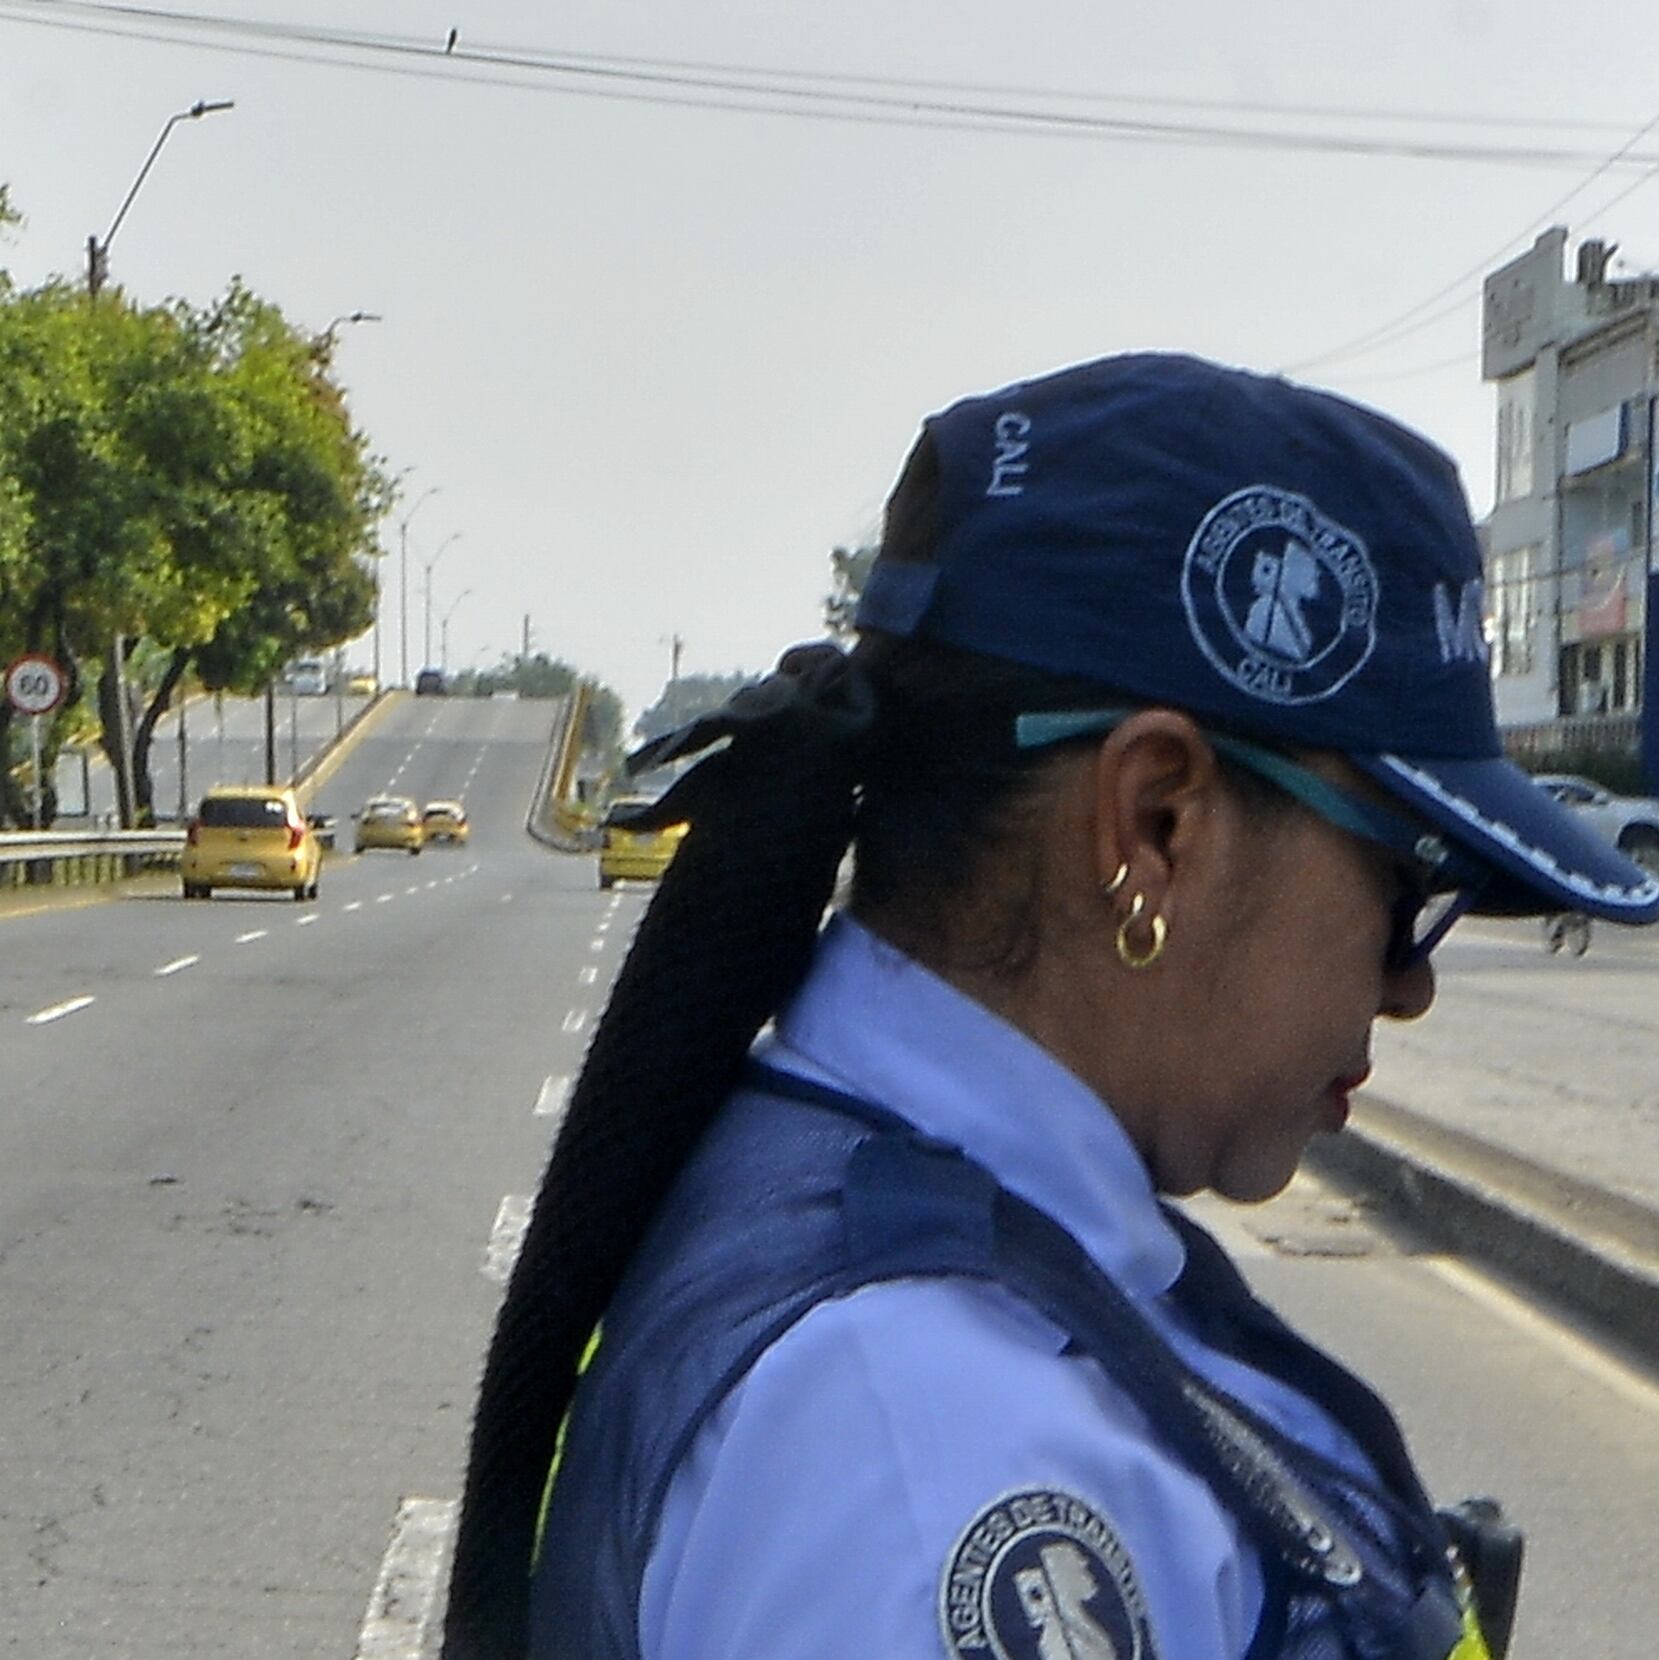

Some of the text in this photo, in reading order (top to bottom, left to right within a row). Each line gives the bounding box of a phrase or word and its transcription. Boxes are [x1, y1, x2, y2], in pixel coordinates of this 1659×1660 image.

[986, 413, 1031, 495] CALI
[20, 674, 48, 695] 60
[1239, 658, 1292, 692] CALI
[953, 1511, 1014, 1650] AGENTES
[1010, 1496, 1053, 1528] DE
